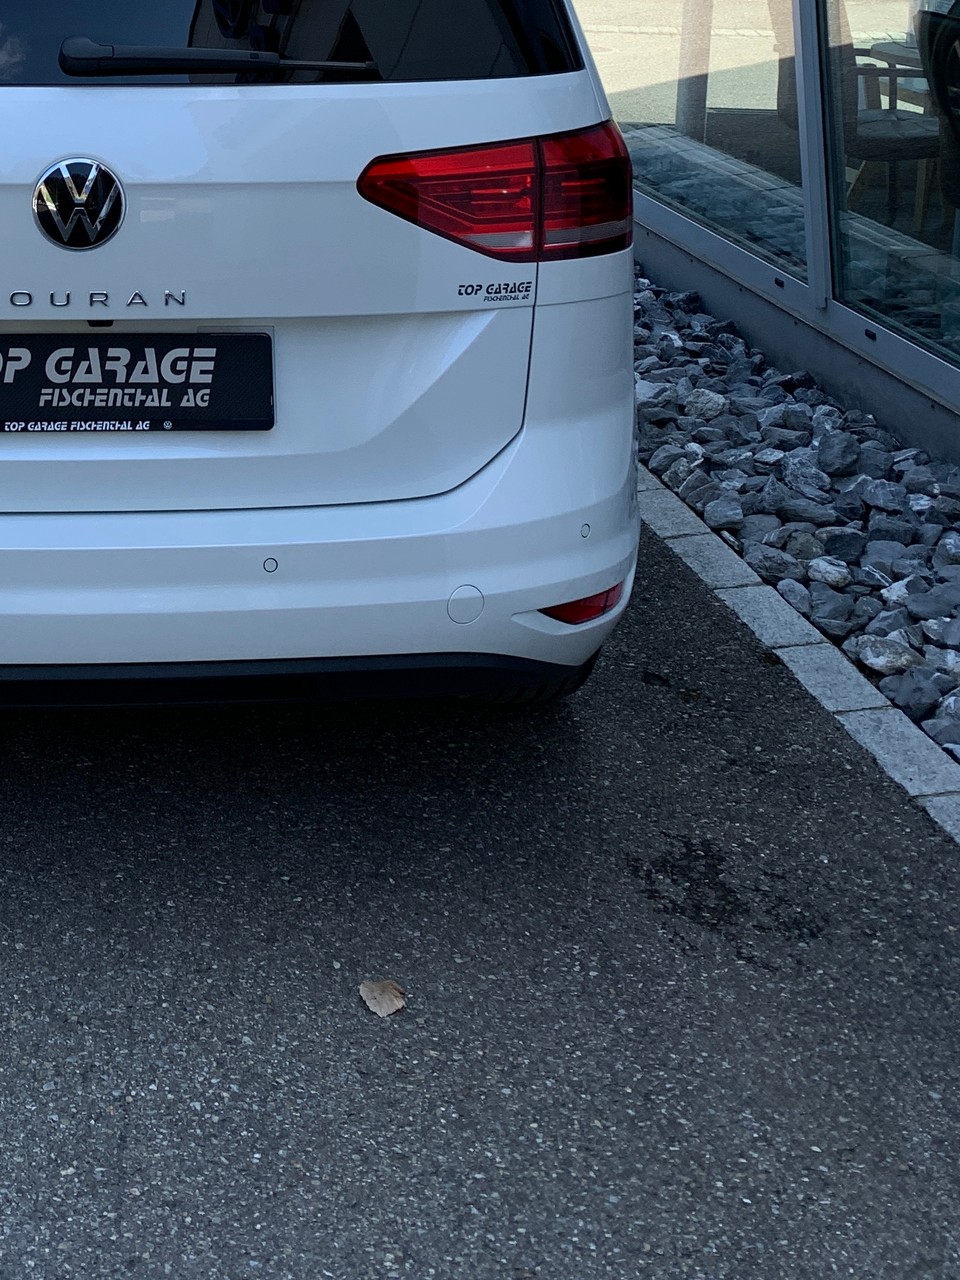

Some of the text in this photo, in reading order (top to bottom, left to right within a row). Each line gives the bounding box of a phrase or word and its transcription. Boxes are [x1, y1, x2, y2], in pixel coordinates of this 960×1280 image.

[34, 158, 124, 250] VW
[457, 281, 533, 296] TOP GARAGE
[44, 346, 218, 385] GARAGE
[38, 387, 211, 408] FISCHENTHAL AG
[4, 421, 25, 432] TOP
[27, 421, 68, 431] GARAGE
[70, 421, 133, 431] FISCHENTHAL
[135, 420, 150, 430] AG
